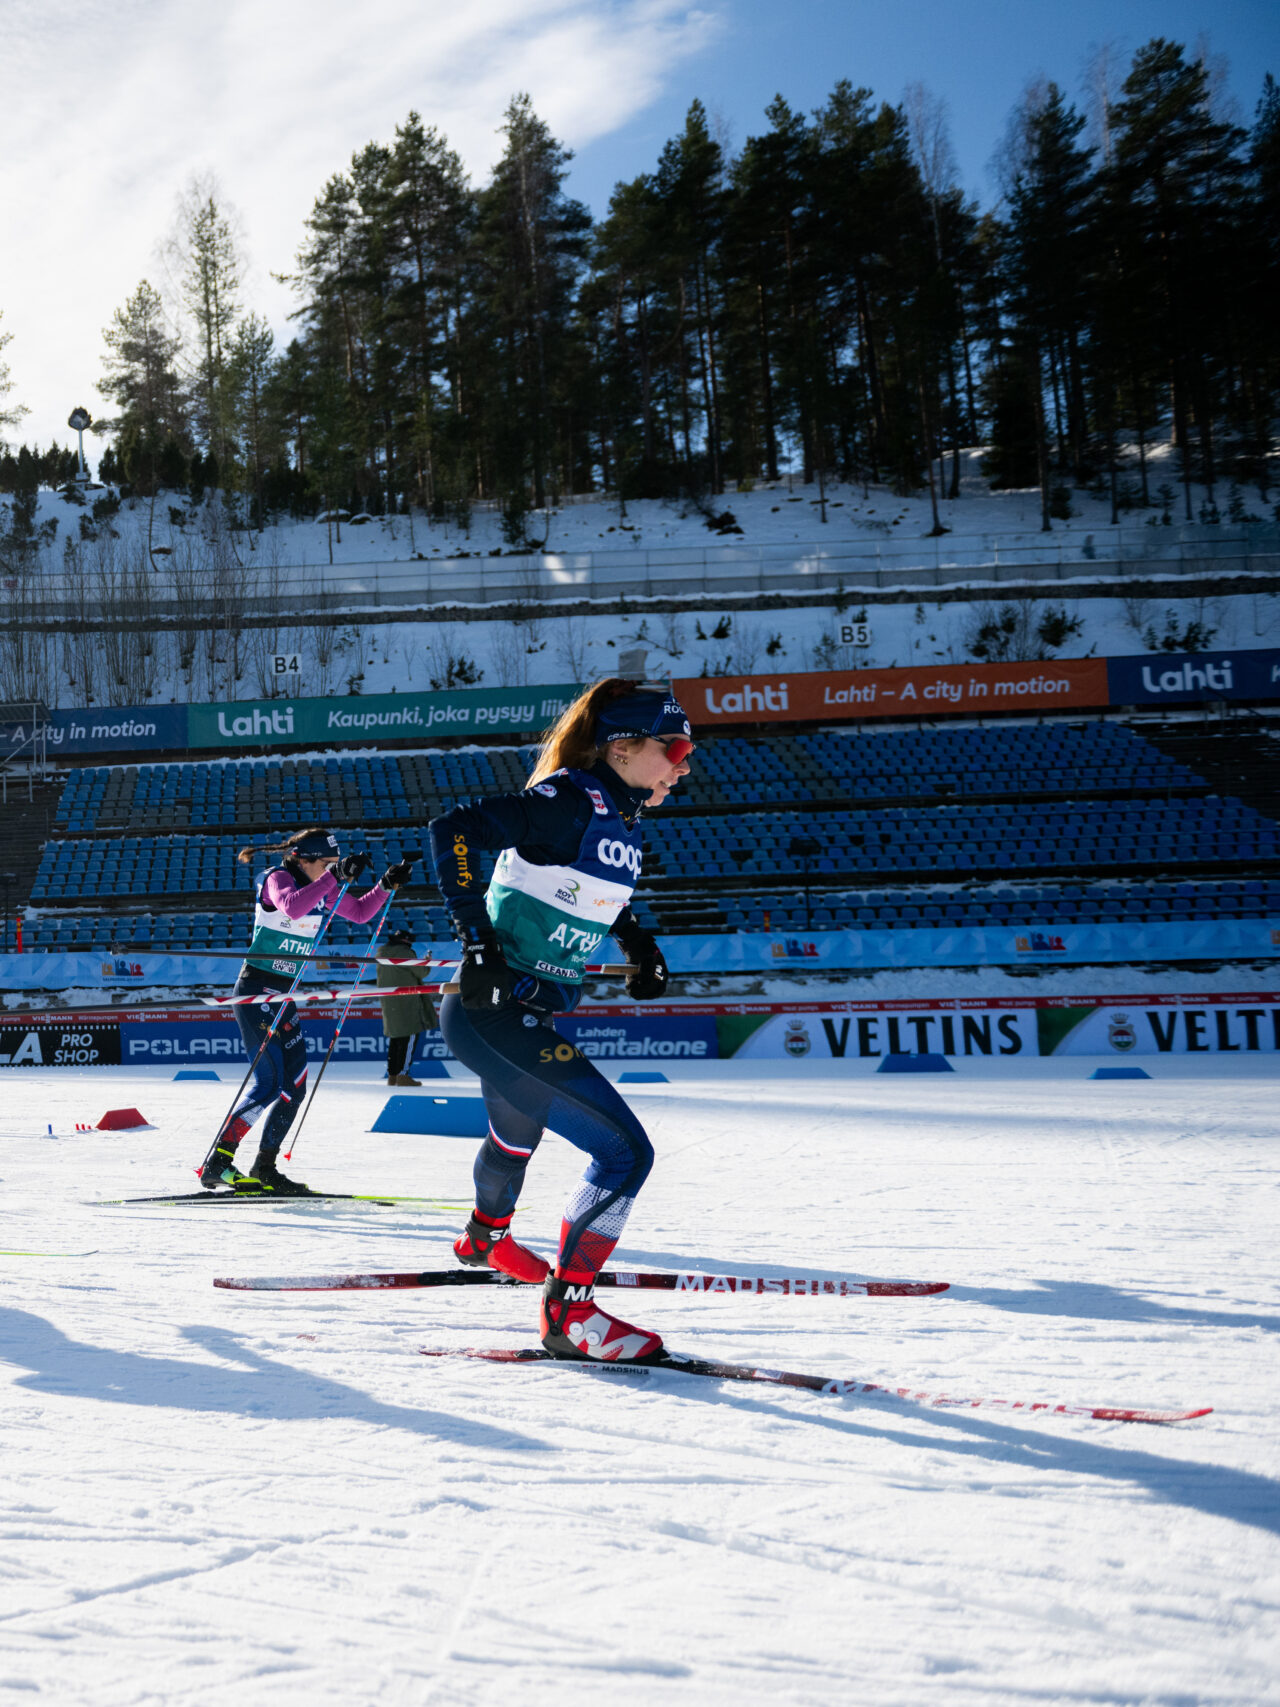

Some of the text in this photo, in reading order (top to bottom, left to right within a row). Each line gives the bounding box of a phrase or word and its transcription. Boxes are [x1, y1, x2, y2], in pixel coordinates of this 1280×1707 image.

[841, 626, 868, 643] B5
[274, 656, 299, 673] B4
[1142, 660, 1232, 692] Lahti
[705, 683, 788, 713] Lahti
[824, 684, 876, 704] Lahti
[900, 683, 917, 699] A
[923, 680, 963, 702] city
[969, 679, 988, 696] in
[994, 675, 1070, 694] motion
[218, 707, 294, 736] Lahti
[327, 707, 424, 730] Kaupunki,
[425, 704, 469, 727] joka
[475, 703, 535, 724] pysyy
[11, 728, 26, 743] A
[70, 722, 86, 740] in
[91, 719, 156, 738] motion
[453, 834, 473, 889] somfy
[598, 838, 642, 880] coop
[538, 962, 569, 977] CLEAN
[78, 1014, 118, 1023] Wärmepumpen
[61, 1034, 92, 1047] PRO
[576, 1027, 626, 1038] Lahden
[822, 1015, 1022, 1058] VELTINS
[54, 1049, 99, 1063] SHOP
[575, 1037, 708, 1057] rantakone
[675, 1275, 868, 1297] MADSHUS
[601, 1366, 650, 1375] MADSHUS
